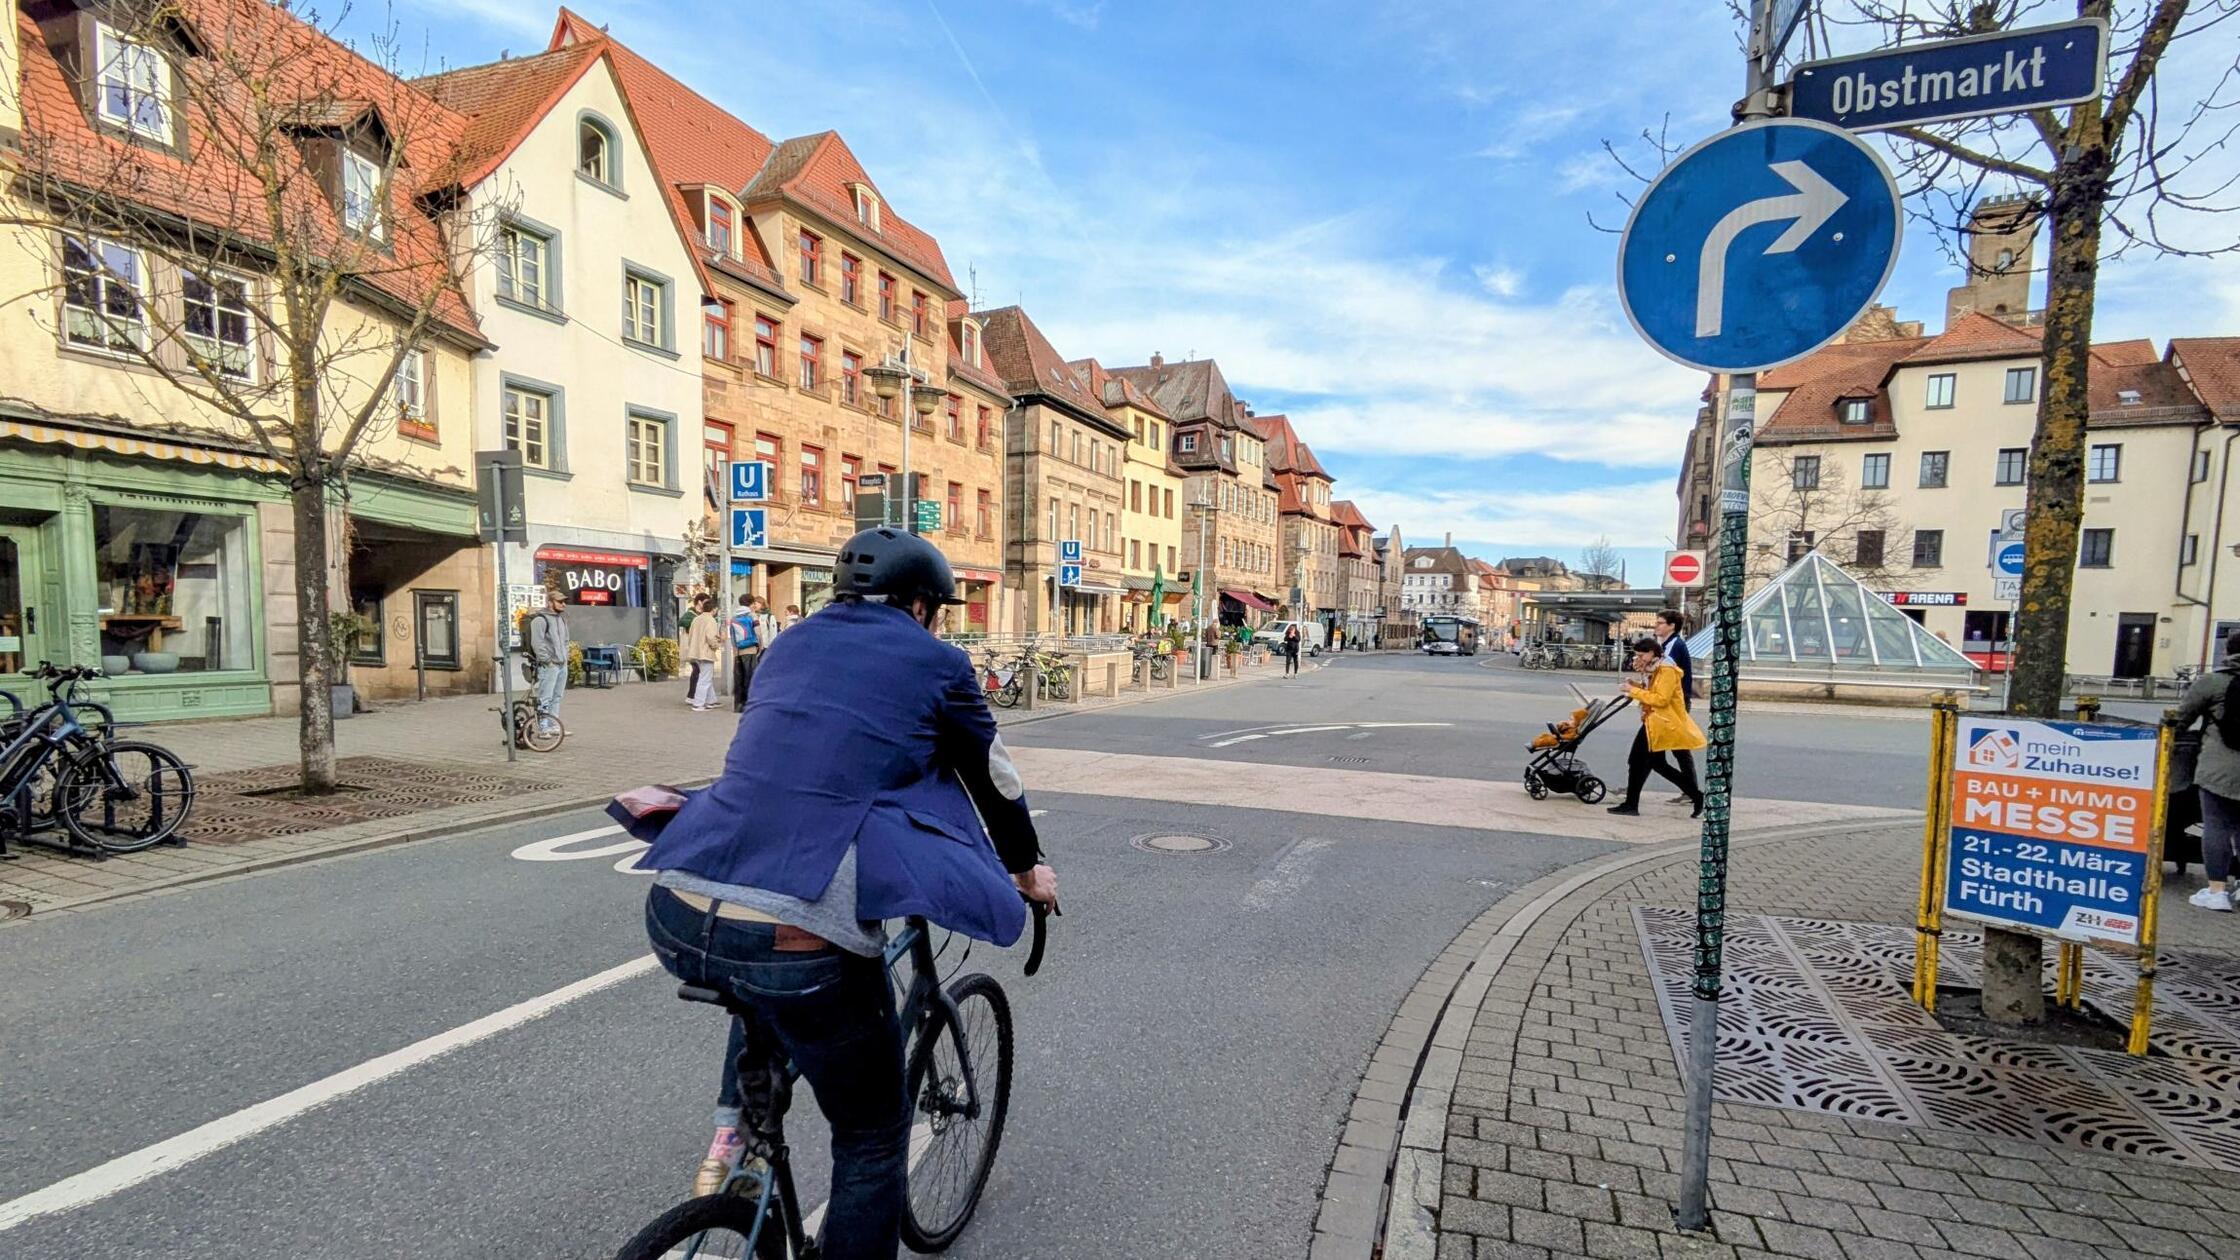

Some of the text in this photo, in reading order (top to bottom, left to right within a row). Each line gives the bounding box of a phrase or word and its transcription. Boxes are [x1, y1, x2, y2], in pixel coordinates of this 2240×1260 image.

[1832, 46, 2047, 115] Obstmarkt
[740, 466, 755, 488] U
[1066, 543, 1075, 555] U
[566, 569, 621, 591] BABO
[2027, 741, 2081, 757] mein
[2024, 756, 2140, 780] Zuhause!
[1967, 779, 2019, 798] BAU
[2051, 788, 2137, 811] IMMO
[1965, 798, 2135, 844] MESSE
[2060, 849, 2132, 876] März
[1961, 858, 2129, 903] Stadthalle
[1960, 880, 2043, 915] Fürth
